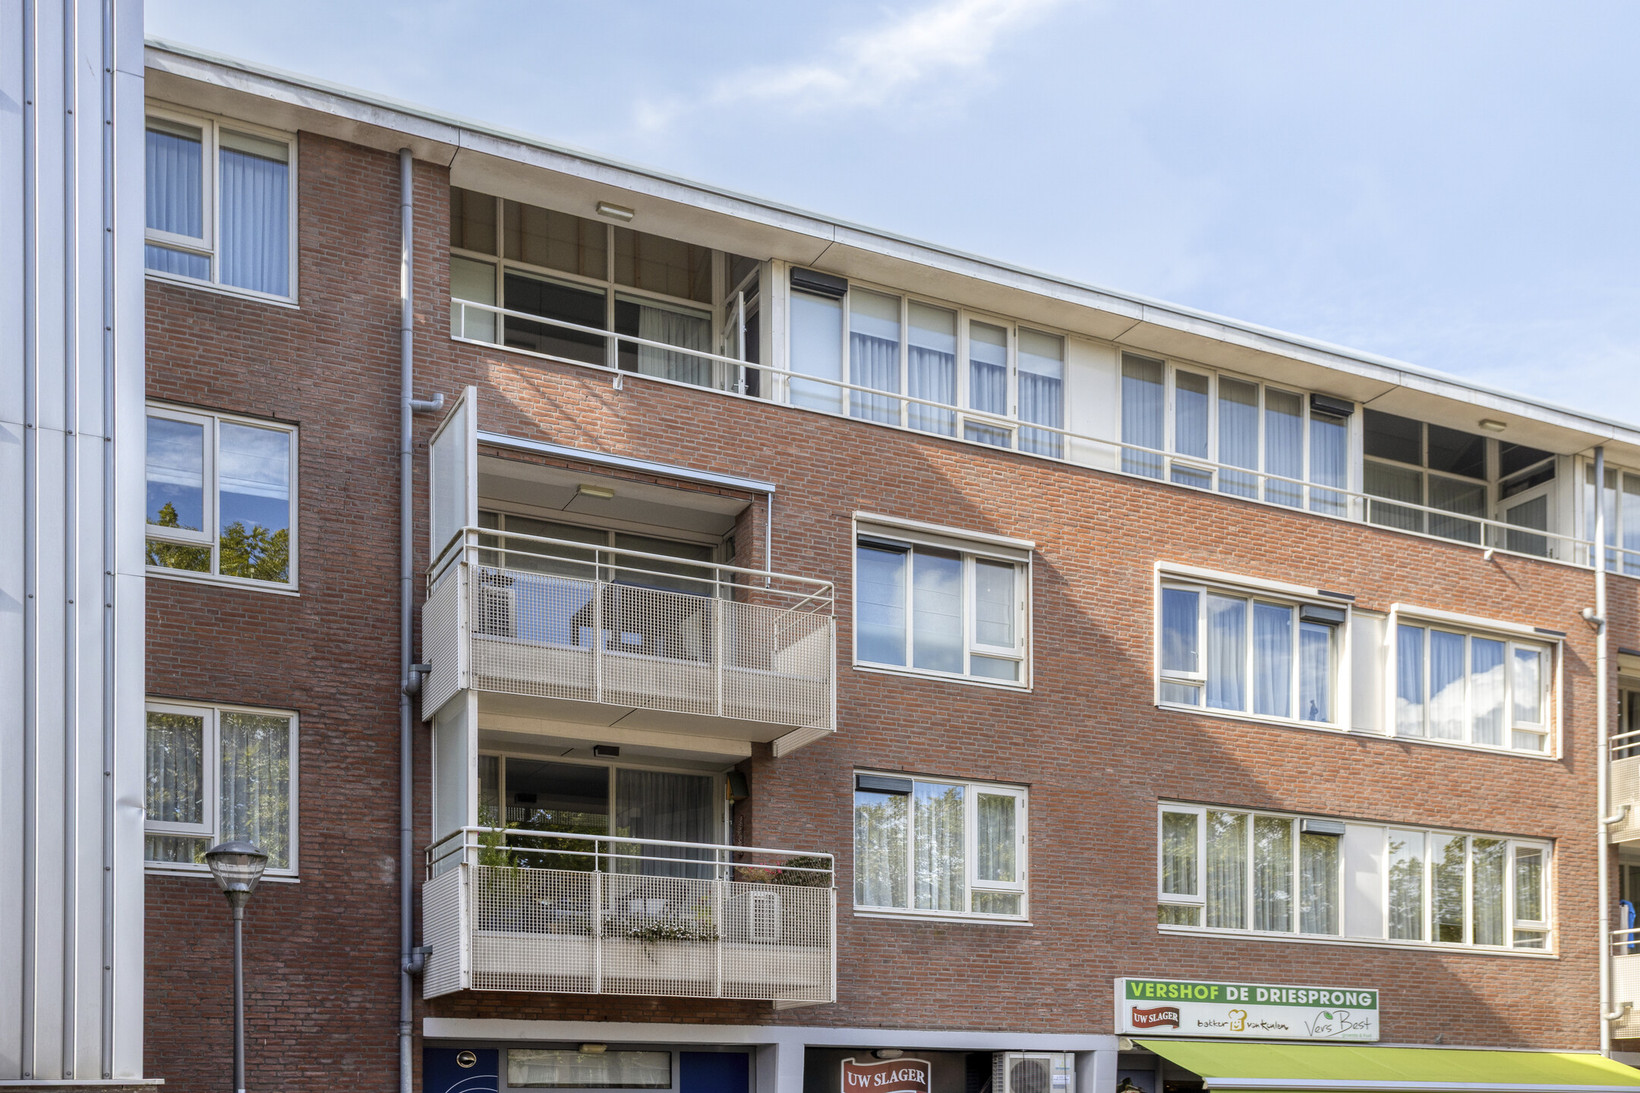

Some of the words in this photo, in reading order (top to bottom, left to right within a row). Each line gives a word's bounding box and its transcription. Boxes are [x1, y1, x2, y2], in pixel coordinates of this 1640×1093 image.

[1131, 982, 1219, 1000] VERSHOF
[1226, 986, 1249, 1001] DE
[1256, 988, 1372, 1006] DRIESPRONG
[1134, 1013, 1148, 1023] UW
[1149, 1011, 1178, 1023] SLAGER
[1304, 1010, 1332, 1037] Vers
[1328, 1010, 1371, 1037] Best
[847, 1071, 871, 1088] UW
[873, 1068, 926, 1087] SLAGER
